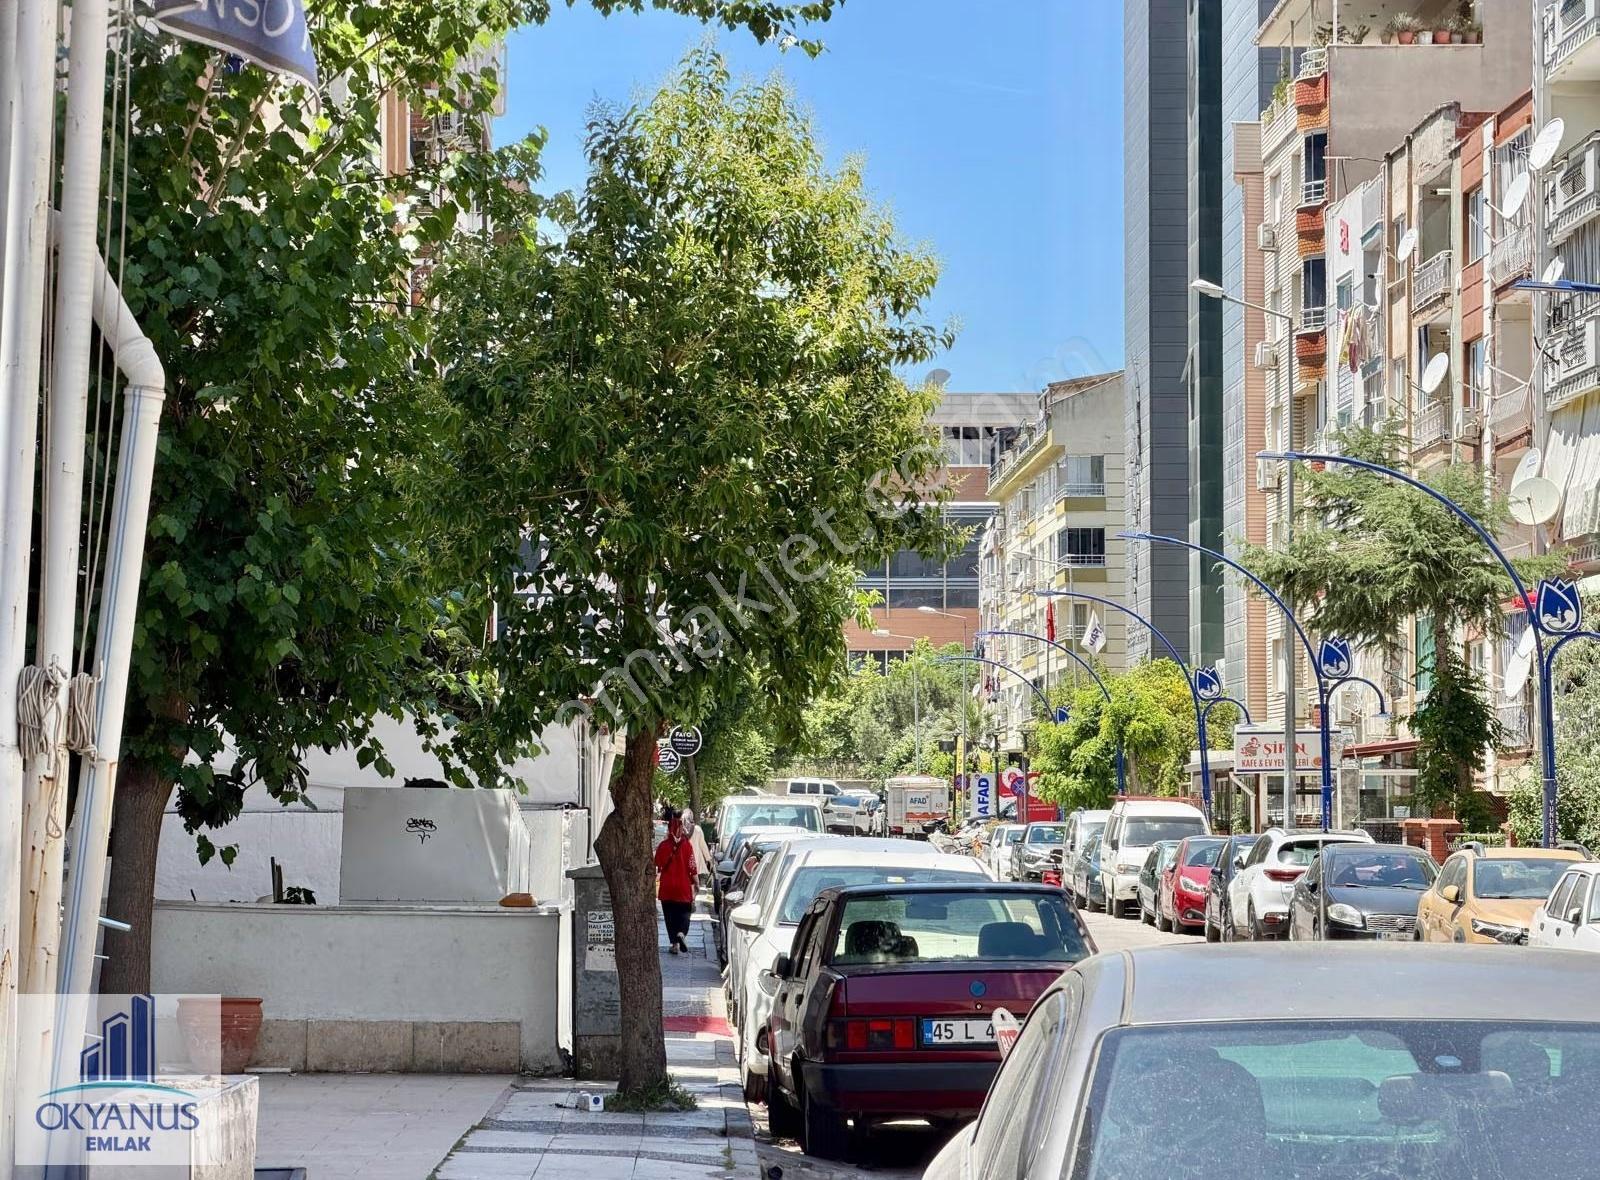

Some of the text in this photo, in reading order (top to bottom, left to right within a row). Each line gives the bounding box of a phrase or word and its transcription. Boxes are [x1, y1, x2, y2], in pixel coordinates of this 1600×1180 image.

[1263, 741, 1309, 757] ŞİRN
[1241, 759, 1257, 767] KAFE
[1265, 759, 1273, 767] EV
[977, 777, 989, 815] AFAD
[934, 1024, 954, 1040] 45
[965, 1024, 974, 1039] L
